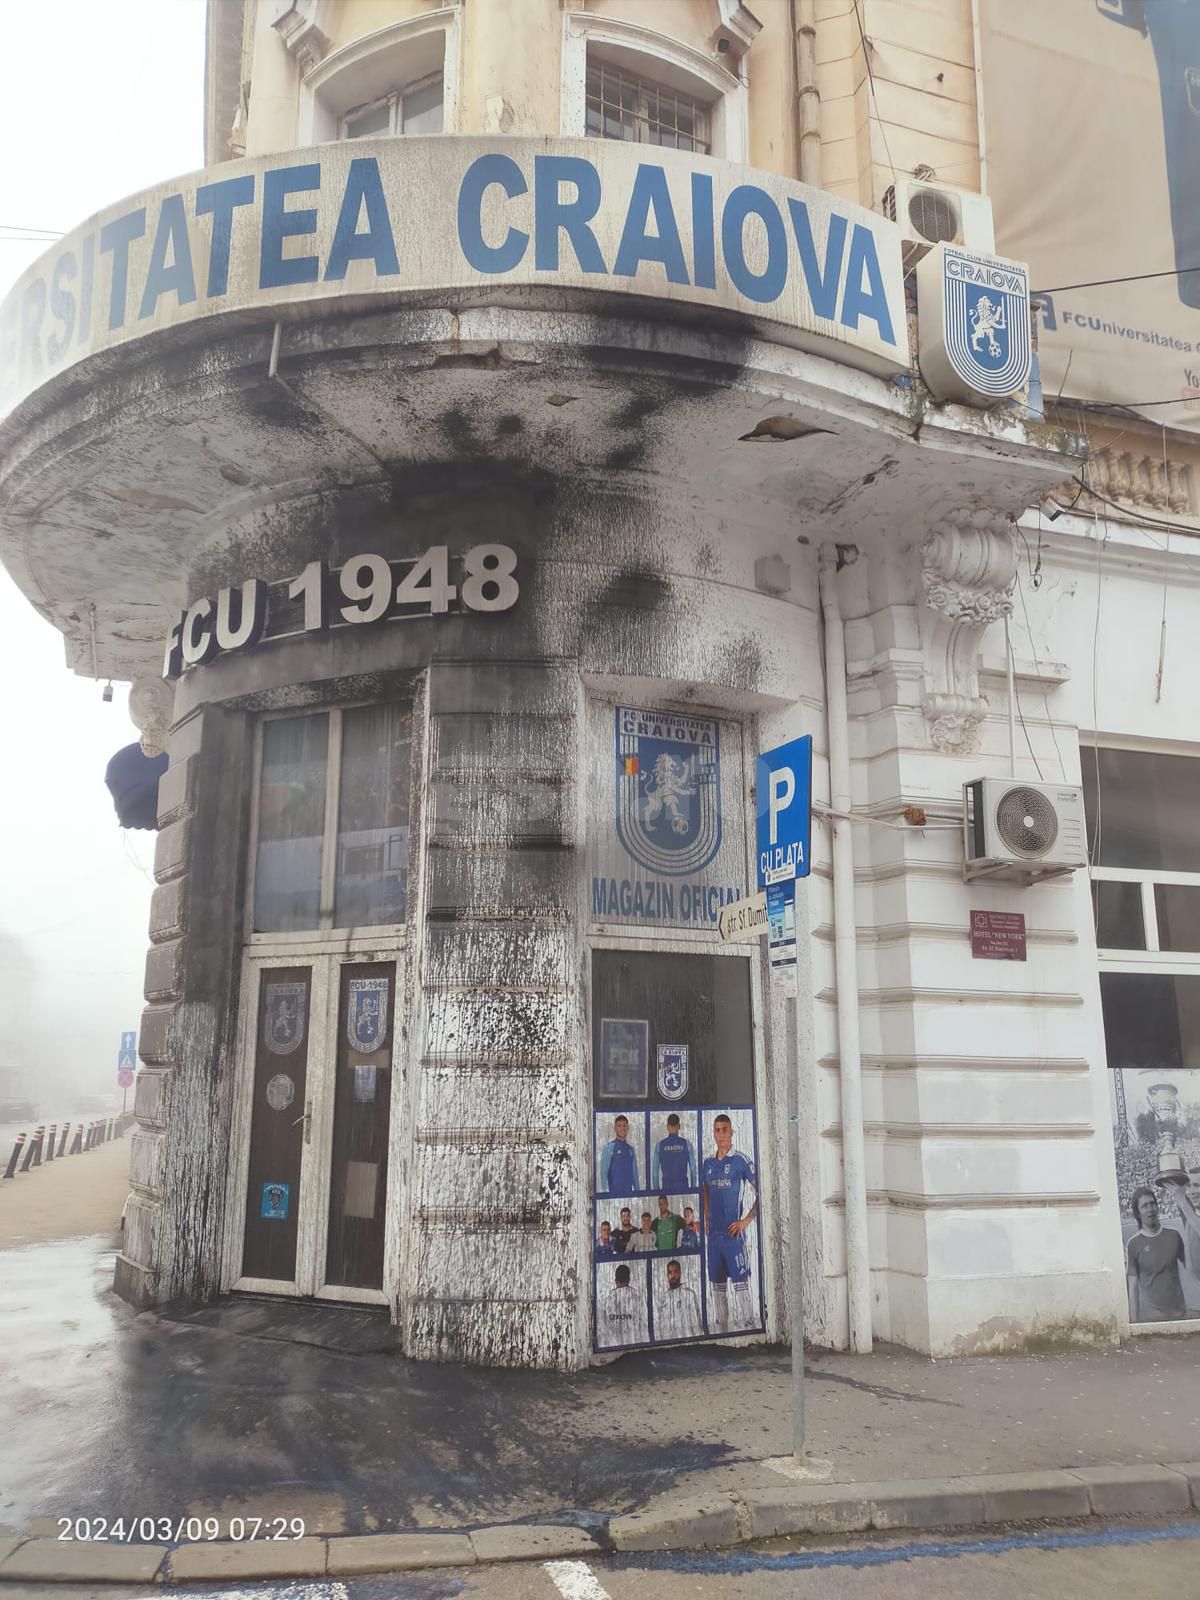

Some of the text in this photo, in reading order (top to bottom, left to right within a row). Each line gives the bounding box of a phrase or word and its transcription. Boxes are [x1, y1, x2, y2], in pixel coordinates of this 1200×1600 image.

[457, 154, 897, 347] CRAIOVA
[946, 259, 1024, 295] CRAIOVA
[1062, 311, 1192, 353] FCUniversitatea
[162, 543, 520, 680] FCU 1948
[623, 720, 712, 744] CRAIOVA
[769, 766, 796, 846] P
[760, 841, 804, 874] CU PLATA
[592, 876, 675, 919] MAGAZIN
[738, 909, 748, 930] Sf.
[973, 930, 992, 938] HOTEL
